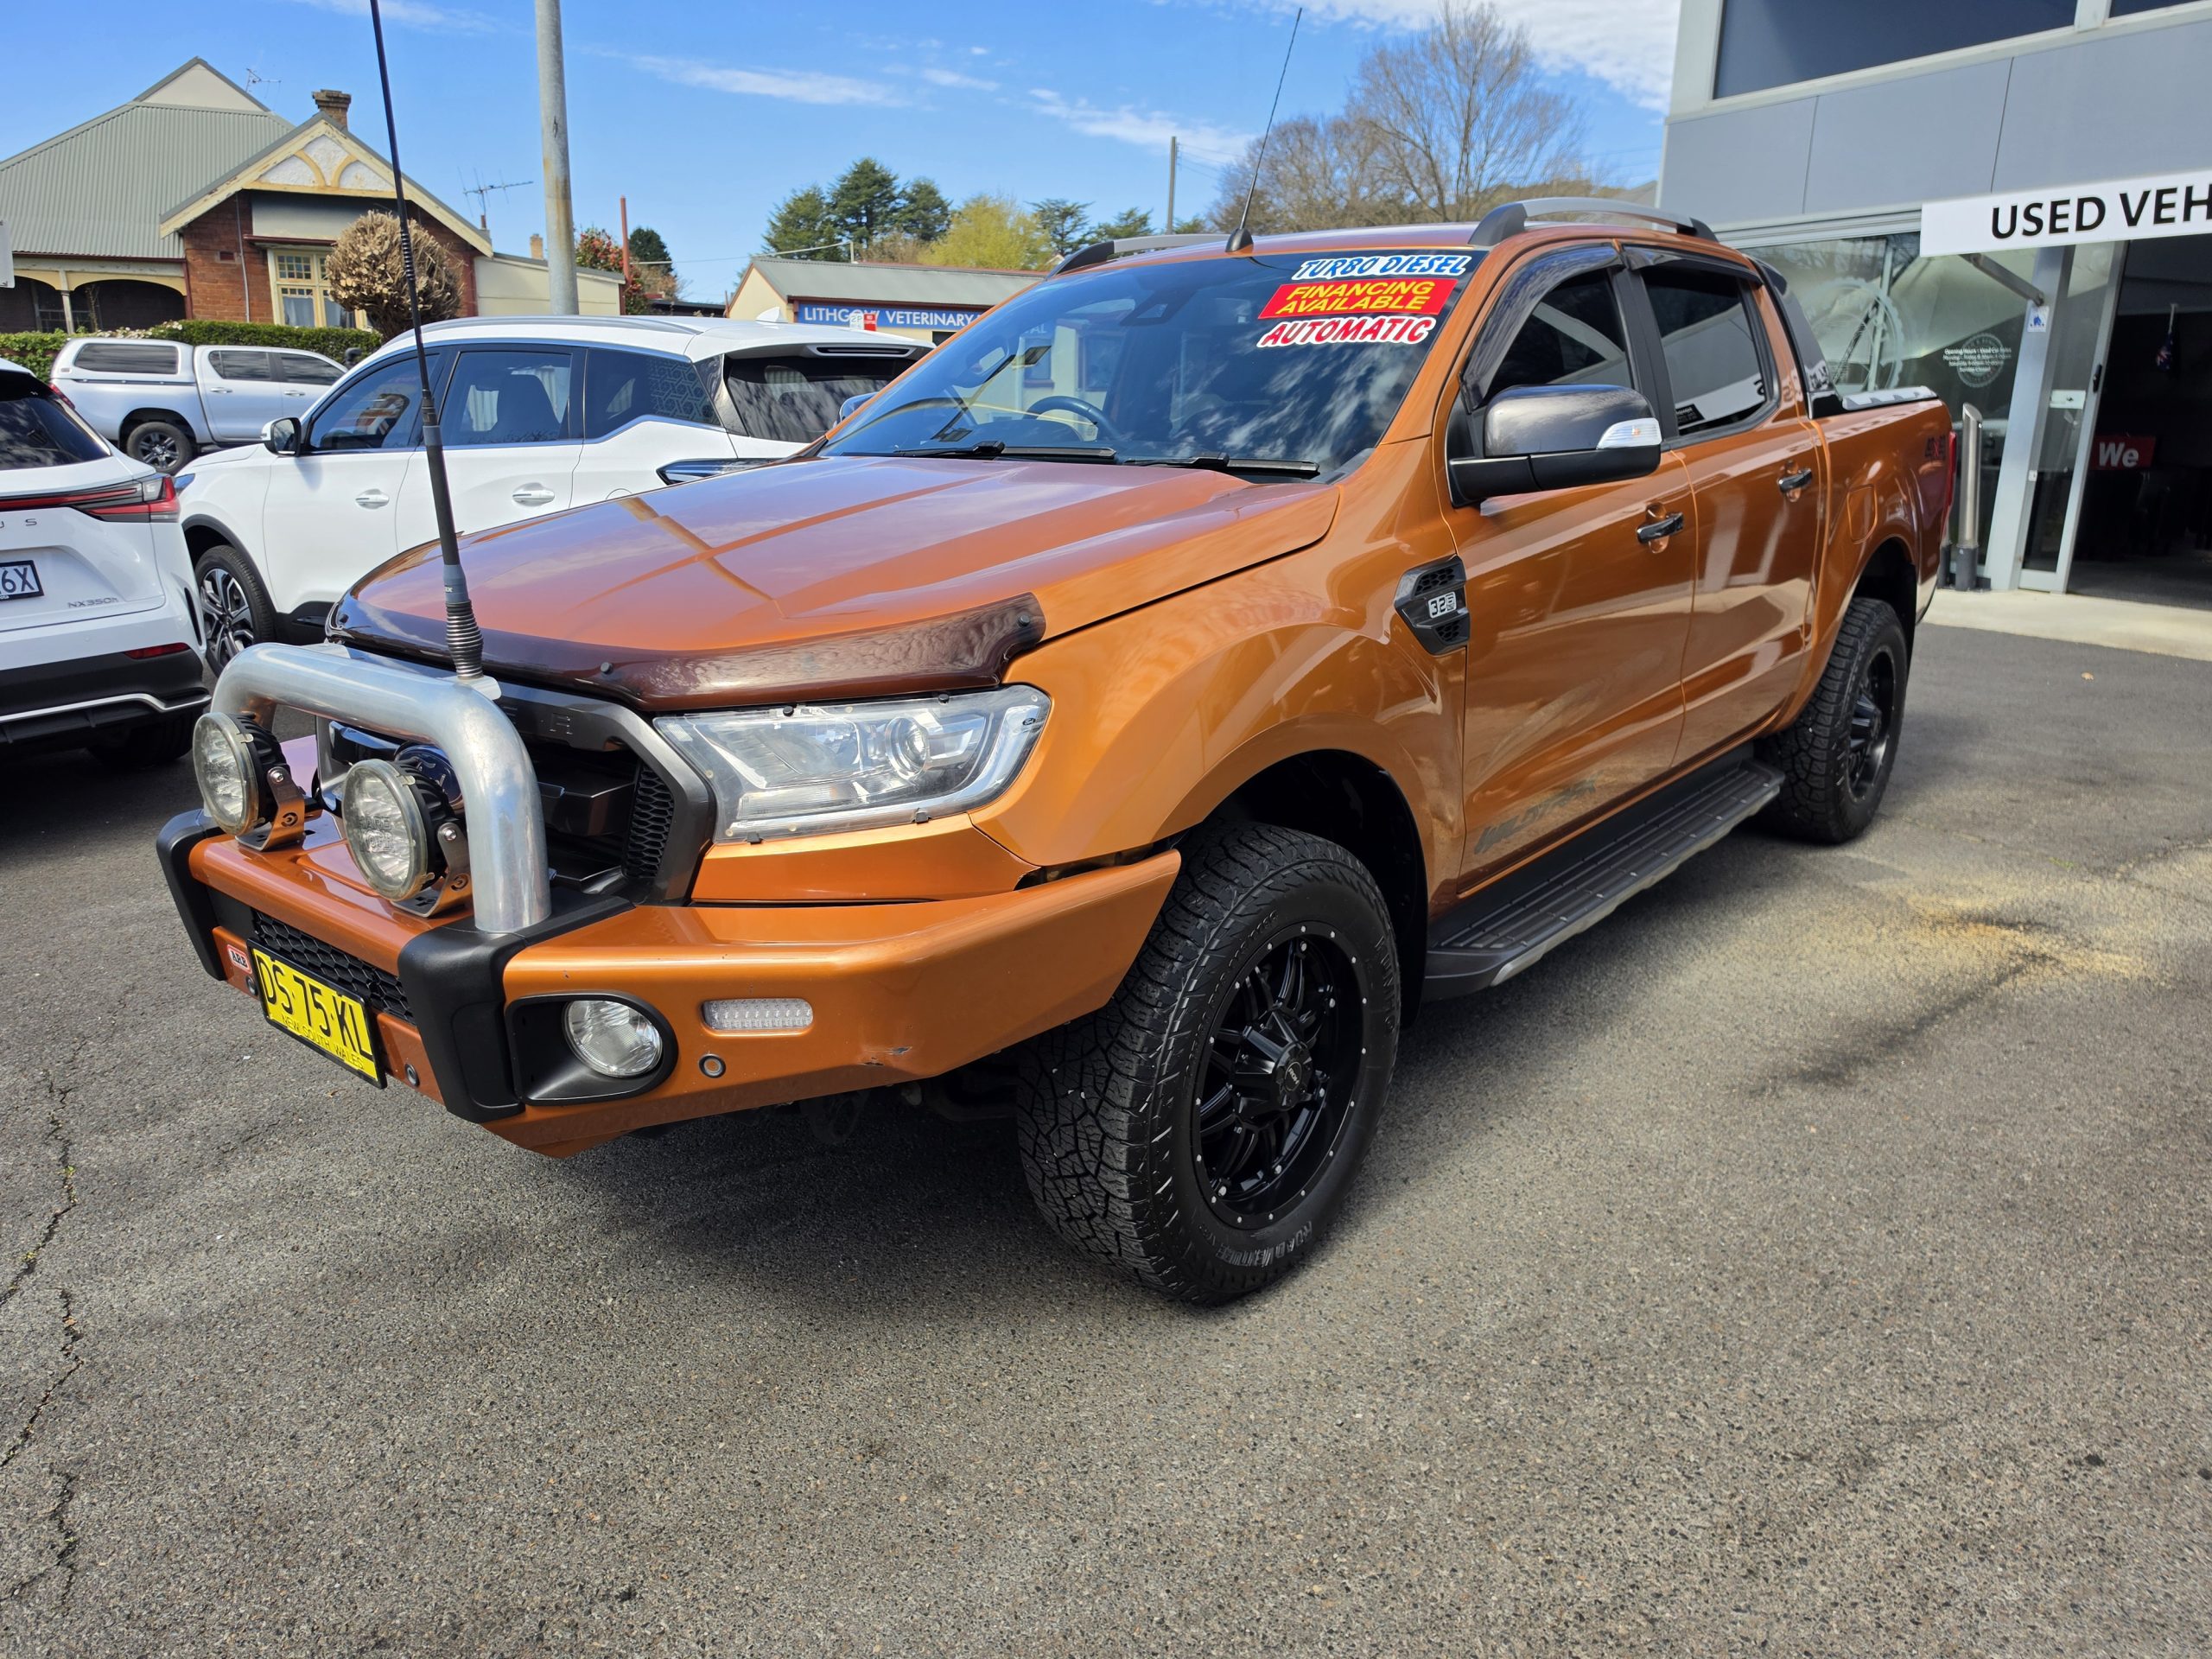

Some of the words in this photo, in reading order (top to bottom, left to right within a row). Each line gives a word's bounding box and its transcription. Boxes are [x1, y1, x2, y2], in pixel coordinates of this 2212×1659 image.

[1992, 196, 2106, 239] USED
[2120, 183, 2212, 227] VEH
[1296, 257, 1379, 277] TURBO
[1380, 255, 1471, 275] DIESEL
[1287, 281, 1435, 301] FINANCING
[1275, 296, 1430, 315] AVAILABLE
[886, 310, 974, 327] VETERINARY
[1260, 317, 1433, 346] AUTOMATIC
[2099, 442, 2139, 467] We
[1, 567, 35, 594] 6X
[282, 1014, 299, 1033] NEW
[302, 1026, 330, 1048] SOUTH
[334, 1044, 364, 1069] WALES
